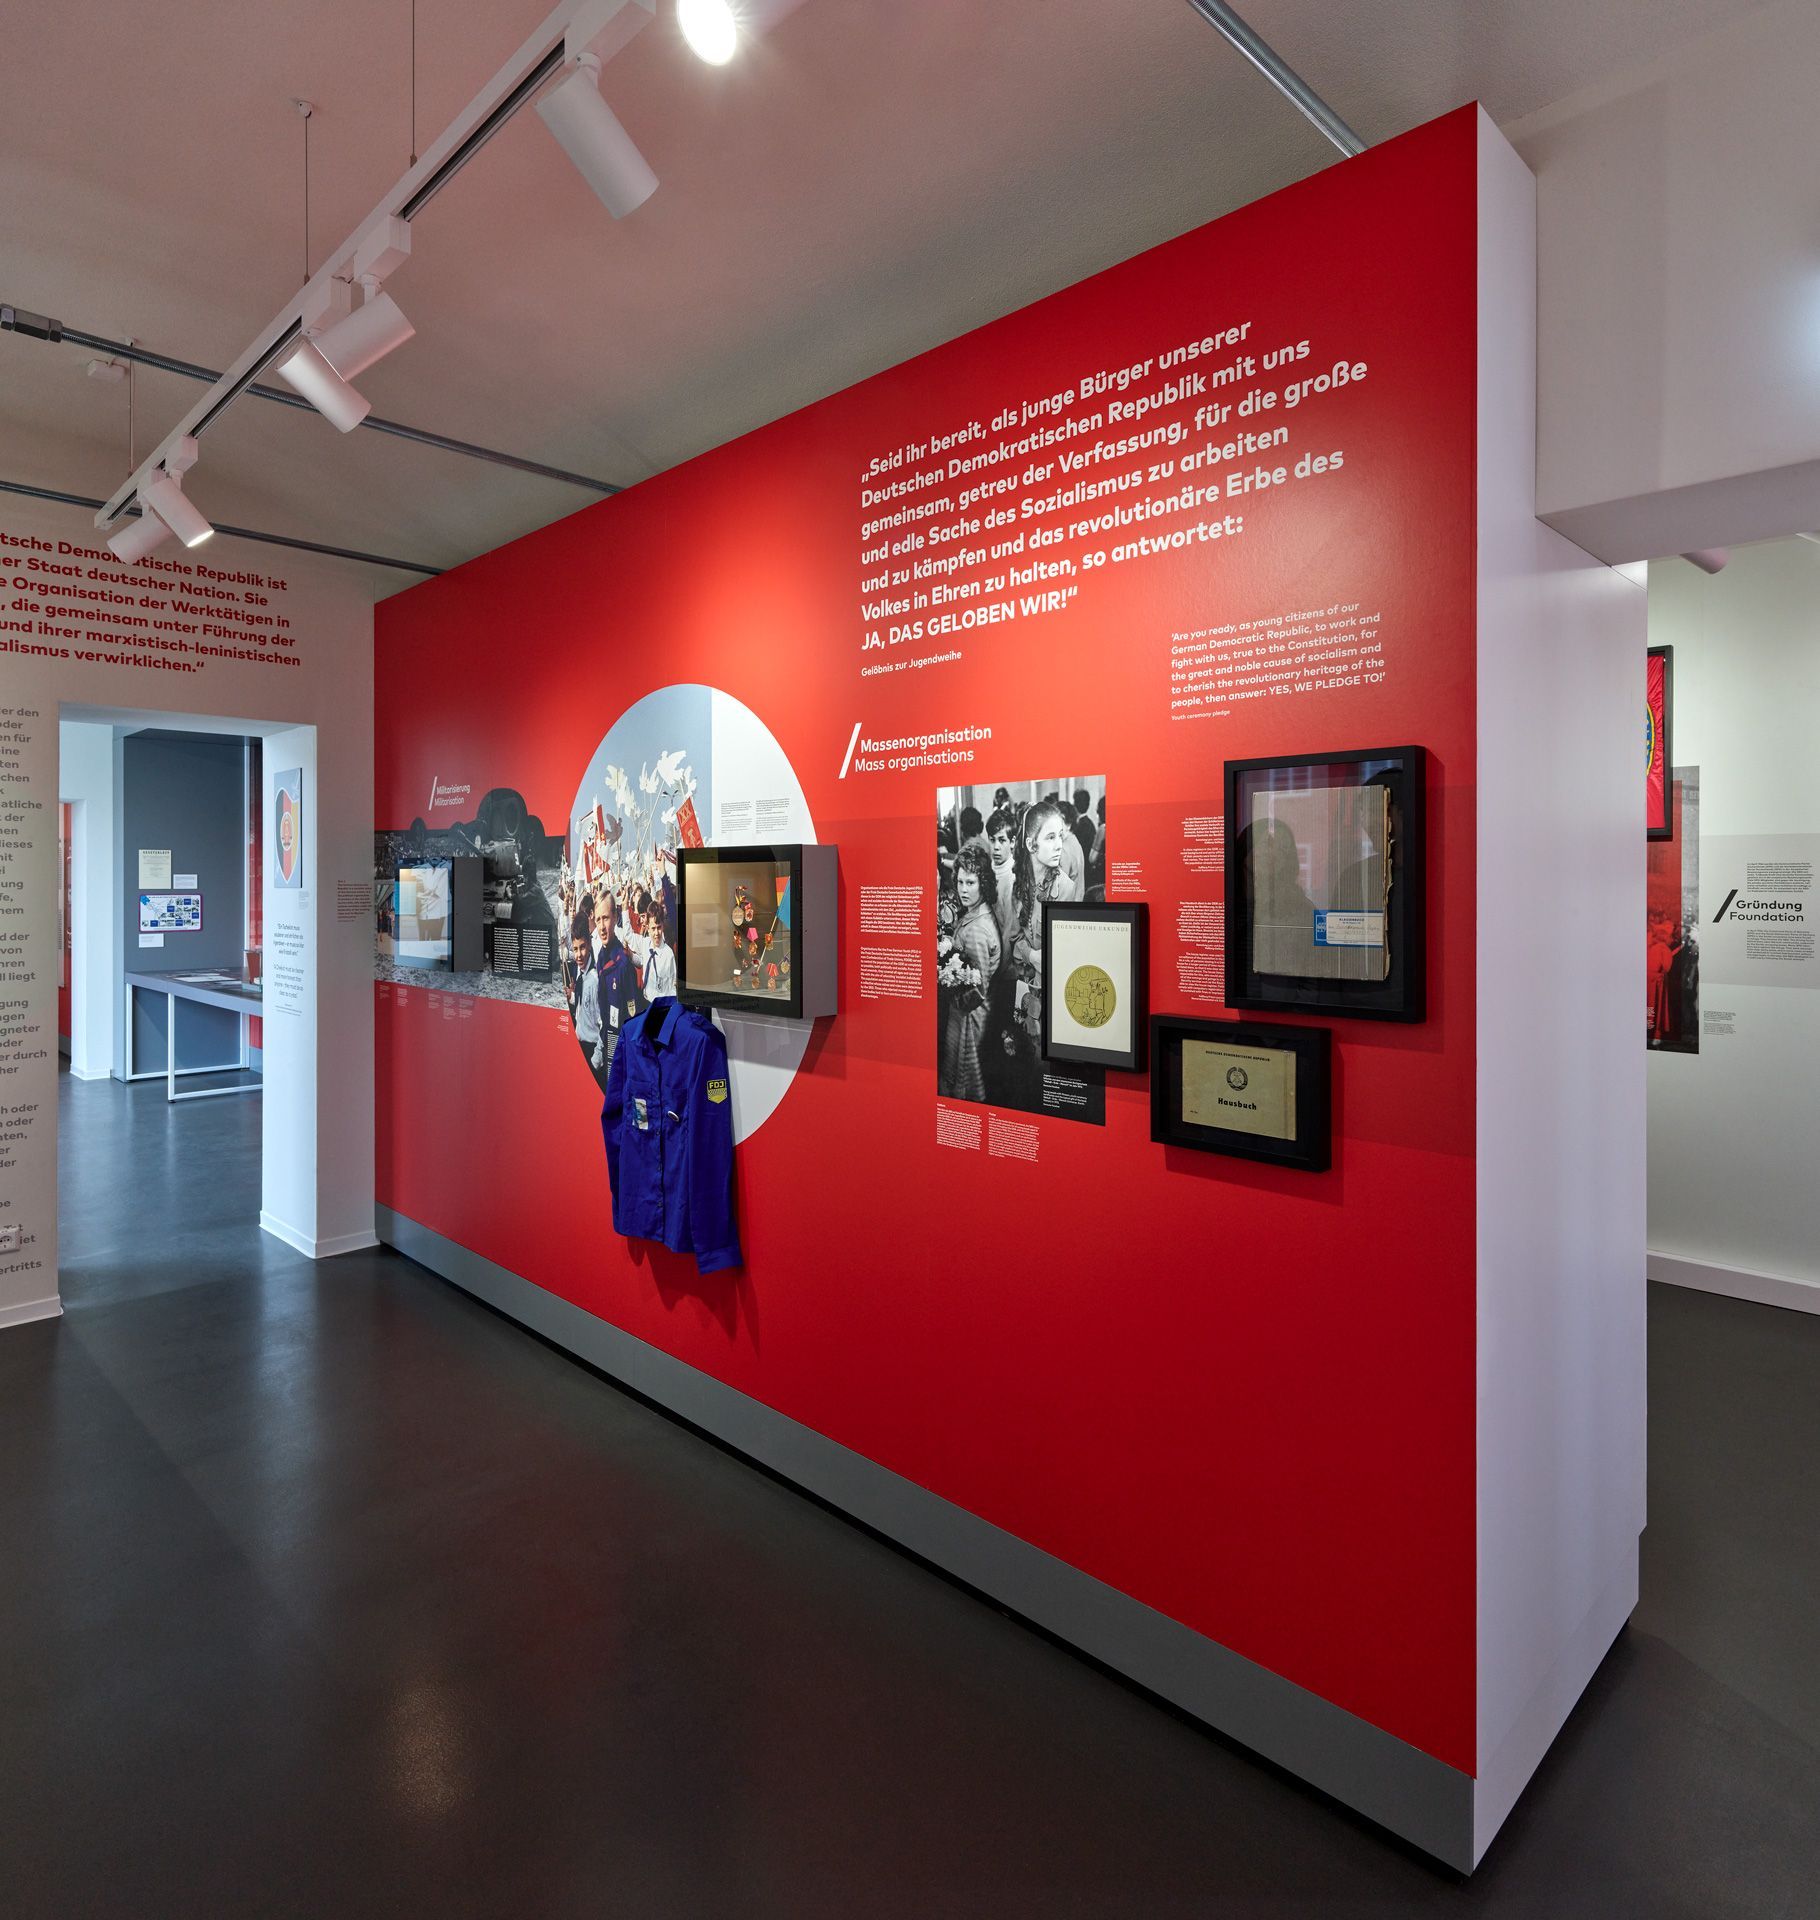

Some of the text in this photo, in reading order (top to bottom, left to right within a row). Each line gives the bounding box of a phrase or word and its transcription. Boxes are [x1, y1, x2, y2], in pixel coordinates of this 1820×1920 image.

[906, 443, 927, 463] ihr
[931, 422, 987, 454] bereit,
[992, 409, 1018, 431] als
[1021, 389, 1074, 426] junge
[1080, 357, 1153, 400] Bürger
[1159, 322, 1251, 370] unserer
[862, 340, 1310, 508] Deutschen Demokratischen Republik mit uns
[862, 361, 1367, 540] gemeinsam, getreu der Verfassung, für die große
[862, 427, 1288, 564] und edle Sache des Sozialismus zu arbeiten
[862, 451, 1343, 593] und zu kämpfen und das revolutionäre Erbe des
[0, 532, 287, 590] tsche Demoktische Republik ist
[862, 515, 1243, 621] Volkes in Ehren zu halten, so antwortet:
[0, 557, 268, 605] er Staat deutscher Nation. Sie
[13, 577, 289, 627] Organisation der Werktätigen in
[12, 599, 295, 647] die gemeinsam unter Führung der
[862, 632, 885, 650] JA,
[890, 621, 923, 645] DAS
[927, 600, 1014, 636] GELOBEN
[1171, 612, 1380, 655] German Democratic Republic, to work and
[1191, 628, 1207, 640] you
[1209, 624, 1237, 635] ready,
[1239, 622, 1250, 630] as
[1253, 617, 1282, 630] young
[1285, 609, 1325, 623] citizens
[1327, 605, 1339, 615] of
[1341, 603, 1359, 612] our
[0, 620, 300, 666] und ihrer marxistisch-leninistischen
[0, 640, 69, 658] alismus
[1171, 630, 1377, 669] fight with us, true to the Constitution, for
[862, 651, 961, 677] Gelöbnis zur Jugendweihe
[1171, 643, 1381, 681] the great and noble cause of socialism and
[1171, 657, 1384, 695] to cherish the revolutionary heritage of the
[1171, 694, 1203, 709] people,
[1205, 691, 1226, 703] then
[1229, 689, 1266, 701] answer:
[1269, 684, 1292, 696] YES,
[1295, 681, 1313, 692] WE
[1315, 674, 1360, 689] PLEDGE
[17, 708, 39, 717] den
[1187, 711, 1211, 719] ceremony
[1213, 709, 1230, 717] pledge
[14, 734, 31, 742] für
[861, 726, 992, 753] Massenorganisation
[855, 749, 974, 772] Mass organisations
[0, 840, 33, 848] ieses
[1730, 912, 1803, 921] Foundation
[1736, 900, 1802, 912] Gründung
[10, 933, 30, 941] der
[9, 972, 35, 982] liegt
[13, 1049, 47, 1060] durch
[709, 1081, 725, 1089] FDJ
[11, 1104, 39, 1113] oder
[1218, 1098, 1257, 1110] Hausbuch
[6, 1118, 34, 1127] oder
